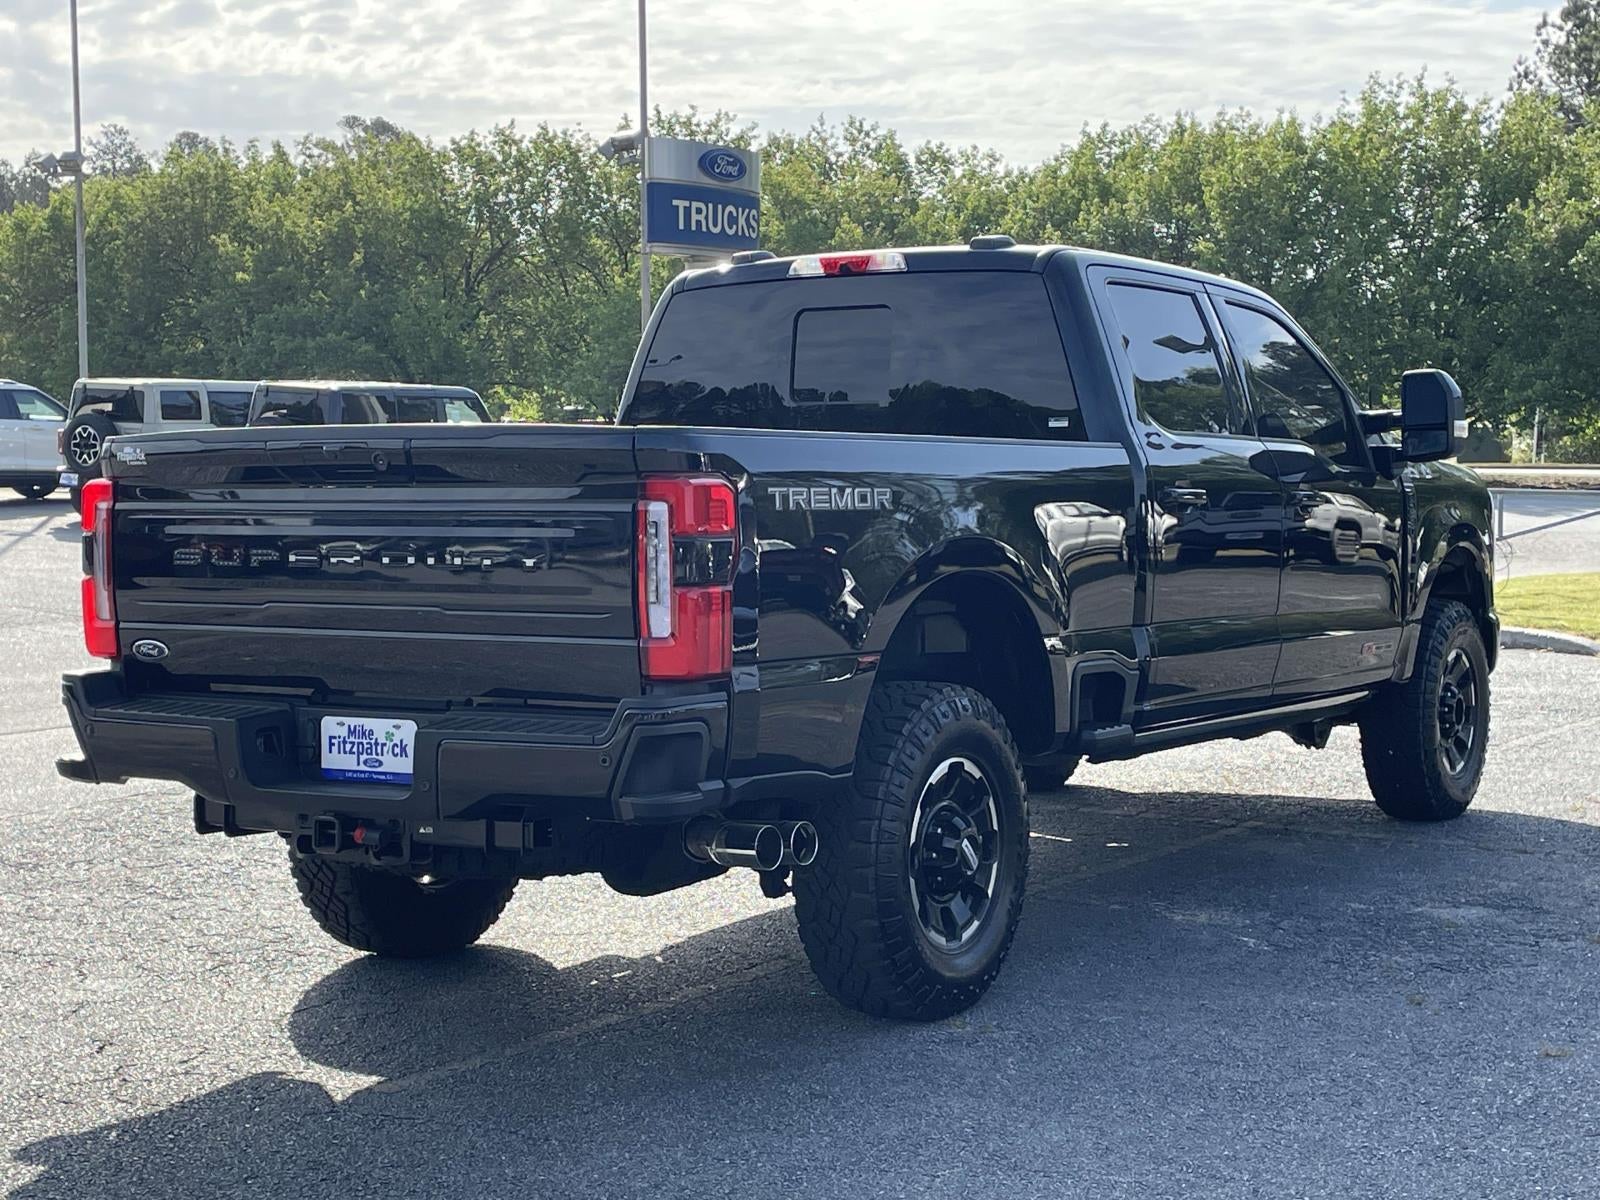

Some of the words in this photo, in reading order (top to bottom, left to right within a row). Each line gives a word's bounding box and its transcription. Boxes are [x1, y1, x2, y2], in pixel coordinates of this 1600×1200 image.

[714, 154, 740, 176] Ford
[672, 199, 758, 239] TRUCKS
[767, 487, 893, 510] TREMOR
[139, 644, 159, 657] Ford
[347, 724, 374, 741] Mike
[328, 733, 408, 766] Fitzpatrick
